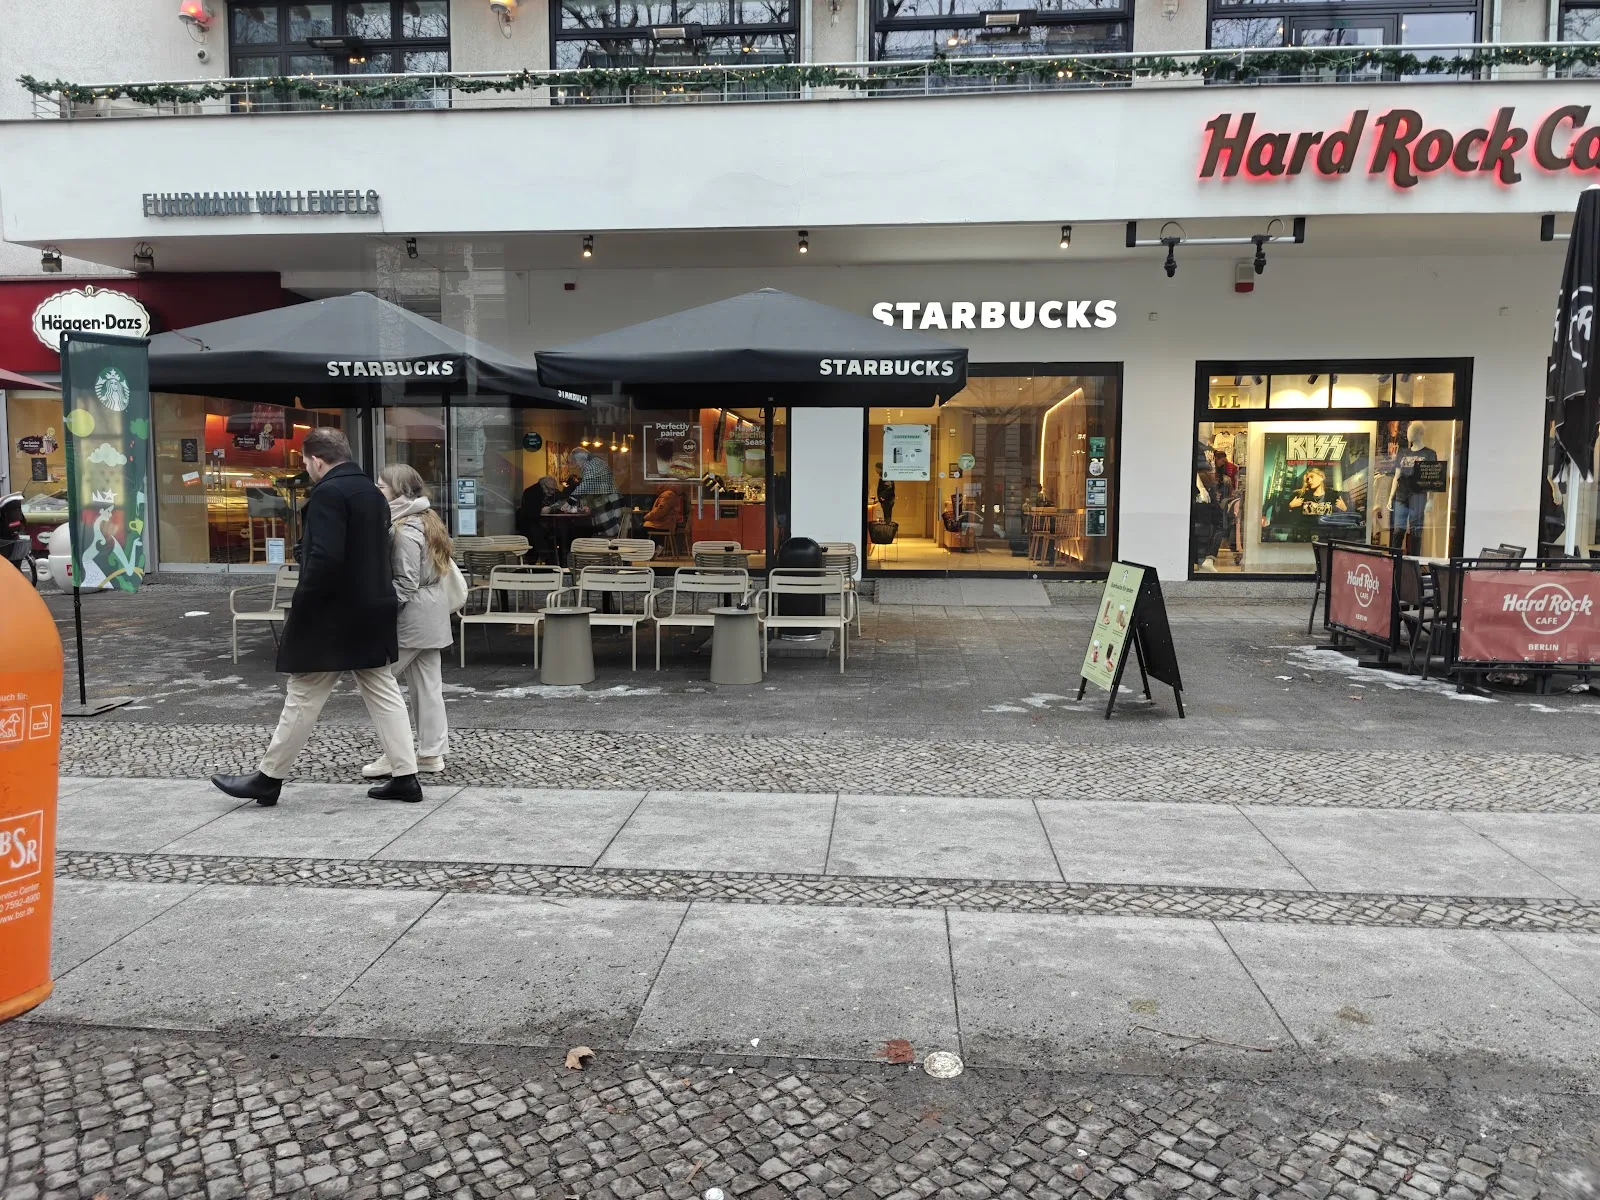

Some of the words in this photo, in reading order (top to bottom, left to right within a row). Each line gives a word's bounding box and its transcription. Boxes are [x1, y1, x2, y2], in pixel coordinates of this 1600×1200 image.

[1199, 109, 1369, 178] Hard
[1369, 106, 1528, 188] Rock
[142, 191, 250, 218] FUHRMANN
[255, 189, 380, 216] WALLENFELS
[872, 299, 1117, 330] STARBUCKS
[326, 360, 454, 377] STARBUCKS
[819, 358, 954, 377] STARBUCKS
[655, 422, 690, 432] Perfectly
[660, 429, 686, 438] paired
[735, 424, 761, 433] Happy
[1286, 434, 1348, 461] KISS
[1346, 570, 1364, 588] Hard
[1364, 573, 1380, 594] Rock
[1502, 593, 1551, 613] Hard
[1548, 594, 1593, 615] Rock
[1535, 617, 1558, 625] CAFE
[1528, 643, 1559, 651] BERLIN
[19, 882, 40, 895] Center
